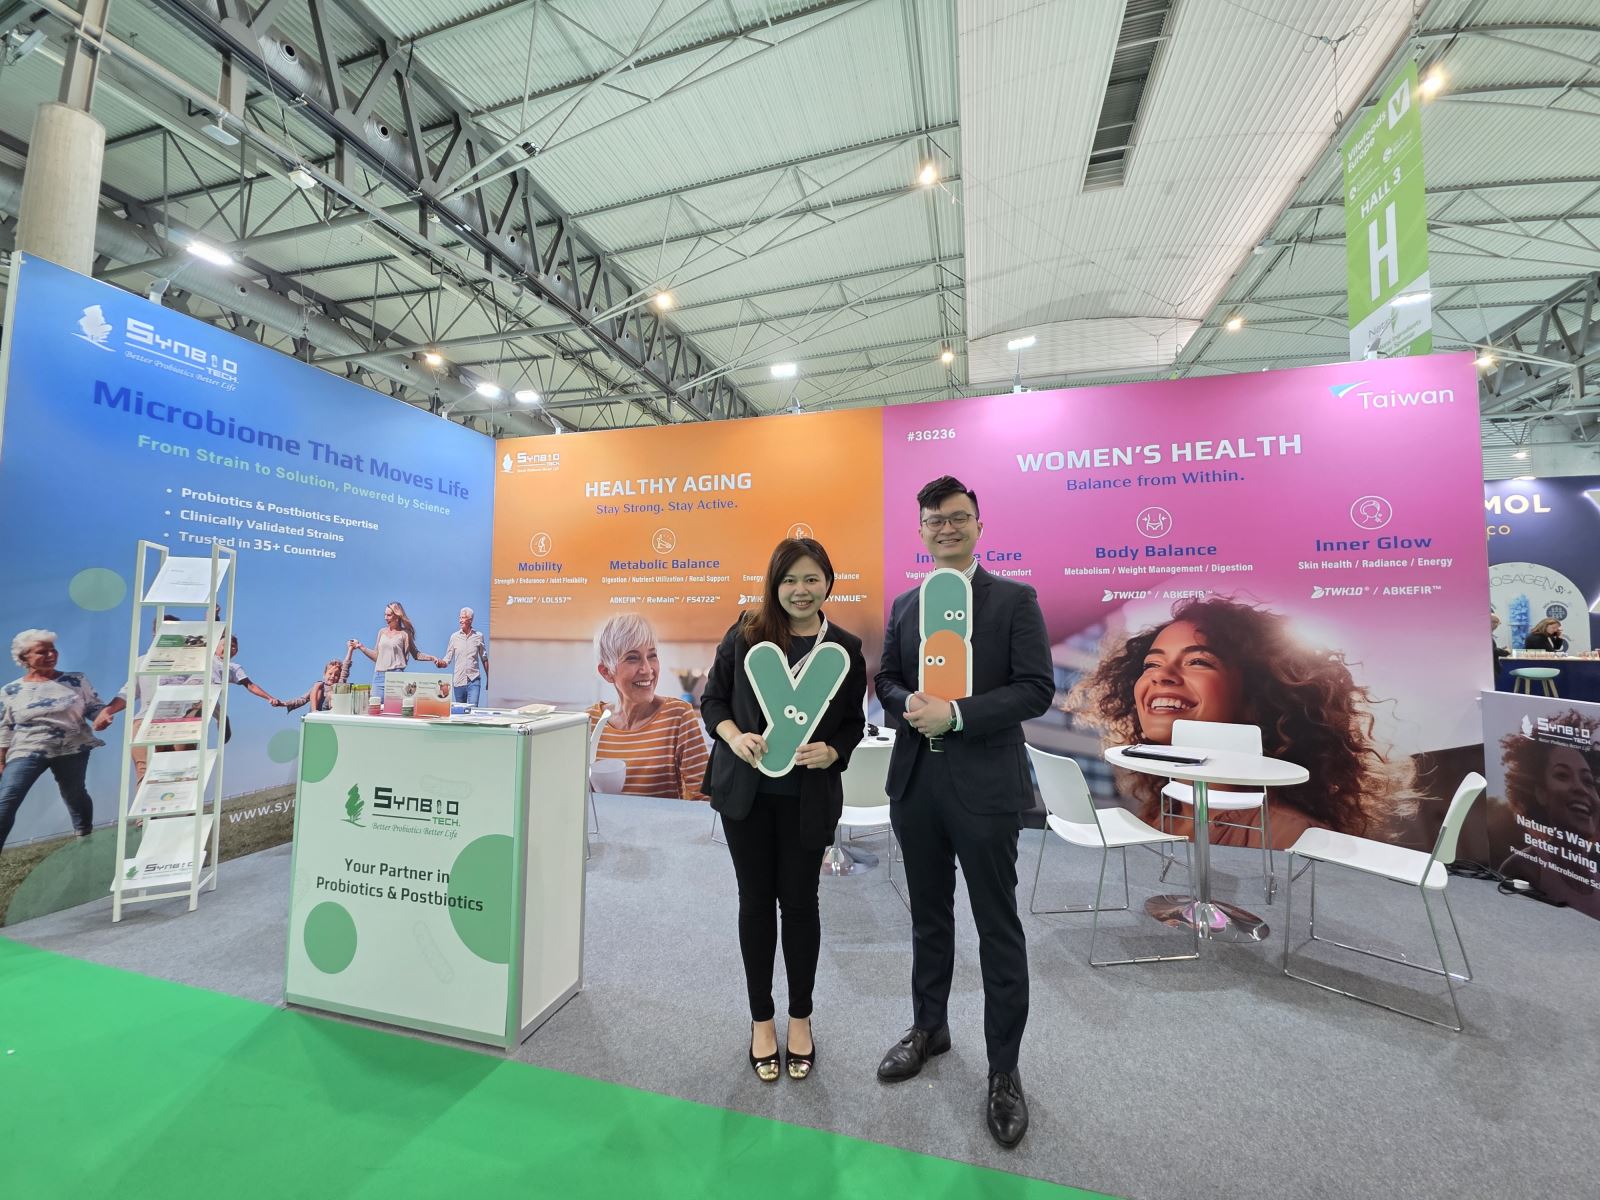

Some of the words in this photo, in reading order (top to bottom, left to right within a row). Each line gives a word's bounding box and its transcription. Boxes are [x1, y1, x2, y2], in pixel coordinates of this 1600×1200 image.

[1360, 179, 1391, 219] HALL
[1393, 166, 1401, 185] 3
[1368, 200, 1399, 302] H
[221, 381, 237, 393] Life
[1356, 389, 1455, 410] Taiwan
[93, 379, 300, 456] Microbiome
[308, 439, 364, 473] That
[369, 457, 433, 491] Moves
[438, 477, 470, 500] Life
[906, 428, 956, 442] #3G236
[1016, 444, 1162, 473] WOMEN'S
[1171, 433, 1302, 463] HEALTH
[137, 434, 190, 458] From
[196, 448, 250, 472] Strain
[255, 462, 271, 476] to
[275, 466, 340, 493] Solution,
[343, 482, 394, 504] Powered
[398, 495, 410, 509] by
[412, 498, 451, 516] Science
[585, 476, 678, 498] HEALTHY
[683, 472, 752, 492] AGING
[1066, 475, 1132, 491] Balance
[1137, 474, 1177, 487] from
[1182, 469, 1245, 484] Within.
[181, 487, 253, 509] Probiotics
[255, 501, 265, 511] &
[267, 502, 331, 523] Postbiotics
[333, 515, 379, 531] Expertise
[596, 504, 619, 516] Stay
[623, 503, 664, 515] Strong.
[668, 501, 693, 513] Stay
[697, 499, 738, 510] Active.
[179, 509, 244, 530] Clinically
[246, 519, 304, 537] Validated
[306, 528, 344, 543] Strains
[179, 531, 235, 547] Trusted
[238, 538, 250, 549] in
[253, 539, 281, 551] 35+
[283, 544, 337, 559] Countries
[1095, 545, 1139, 561] Body
[1145, 544, 1217, 557] Balance
[1315, 539, 1370, 552] Inner
[1377, 535, 1432, 550] Glow
[609, 559, 668, 570] Metabolic
[671, 559, 720, 570] Balance
[986, 550, 1022, 562] Care
[1298, 560, 1319, 570] Skin
[1321, 560, 1353, 569] Health
[1362, 558, 1408, 568] Radiance
[1417, 557, 1453, 568] Energy
[518, 561, 563, 573] Mobility
[1001, 569, 1032, 577] Comfort
[1064, 567, 1110, 576] Metabolism
[1118, 566, 1147, 576] Weight
[1148, 564, 1203, 575] Management
[1211, 563, 1253, 573] Digestion
[601, 576, 627, 584] Digestion
[655, 575, 684, 583] Utilization
[706, 575, 730, 583] Support
[742, 574, 764, 583] Energy
[372, 822, 391, 832] Better
[392, 823, 422, 835] Probiotics
[423, 827, 443, 836] Better
[444, 830, 458, 840] Life
[1516, 813, 1564, 840] Nature's
[1565, 830, 1593, 853] Way
[1524, 832, 1559, 855] Better
[1560, 846, 1598, 874] Living
[344, 858, 376, 874] Your
[379, 862, 433, 881] Partner
[437, 869, 450, 884] in
[1509, 845, 1538, 863] Powered
[1538, 857, 1548, 868] by
[1548, 861, 1590, 885] Microbiome
[316, 876, 383, 898] Probiotics
[387, 886, 397, 900] &
[400, 887, 484, 912] Postbiotics
